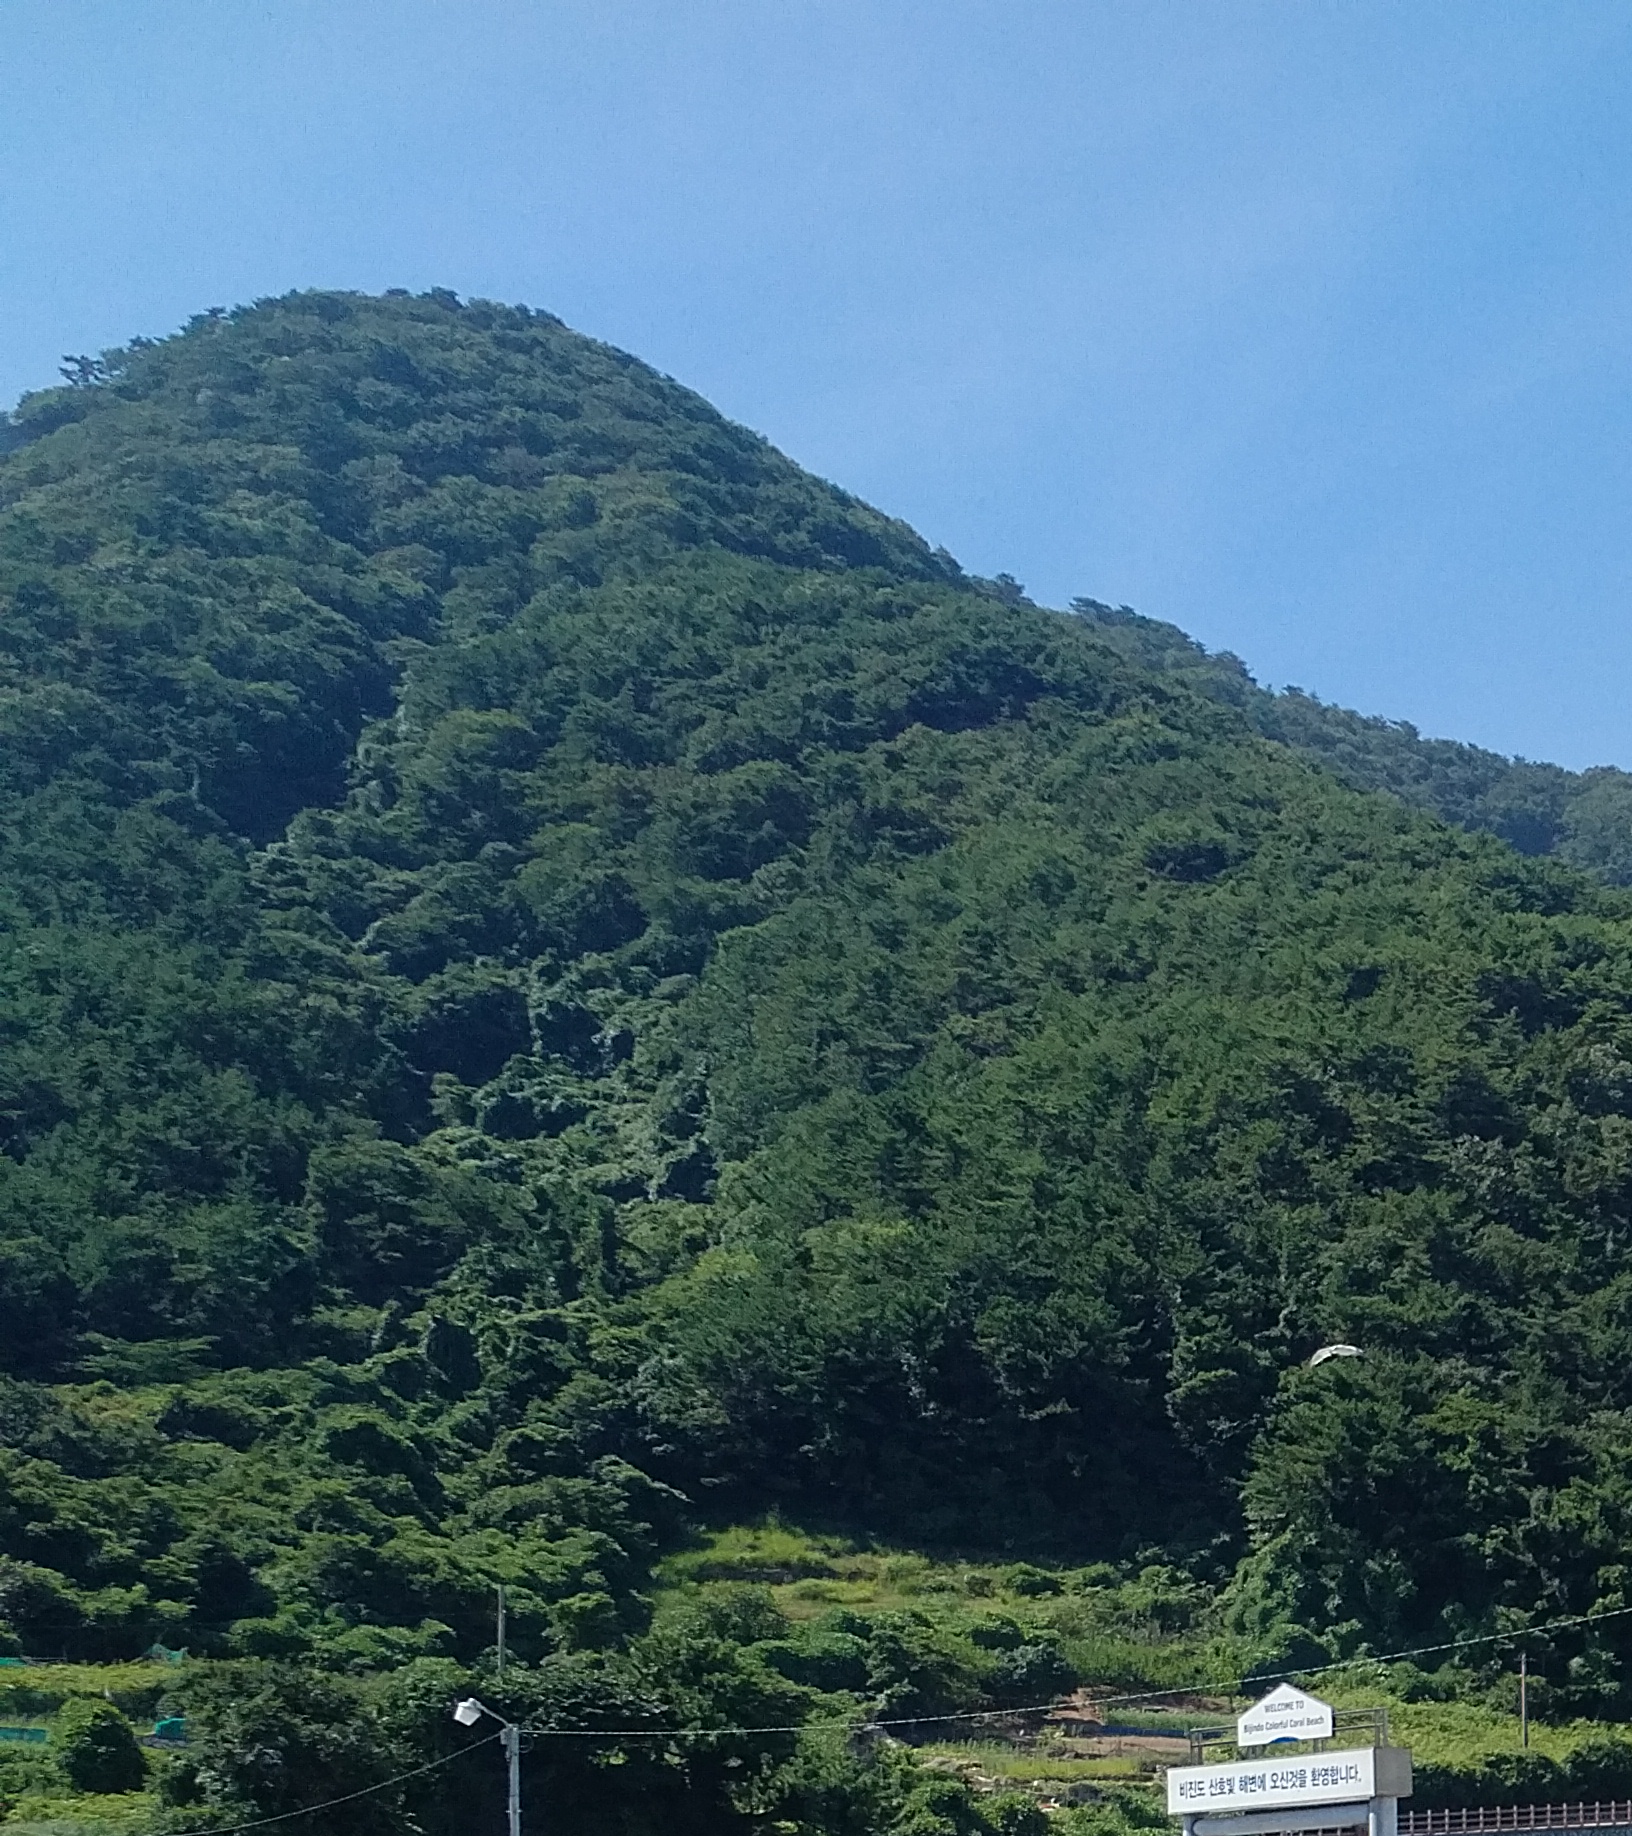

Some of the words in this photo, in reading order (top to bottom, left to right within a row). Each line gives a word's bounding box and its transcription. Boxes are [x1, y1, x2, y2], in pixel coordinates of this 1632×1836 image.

[1264, 1702, 1294, 1713] WELCOME
[1295, 1700, 1305, 1710] TO
[1265, 1719, 1288, 1731] Colorful
[1290, 1718, 1305, 1728] Coral
[1306, 1715, 1325, 1726] Beach
[1179, 1780, 1206, 1799] 비진도
[1208, 1777, 1235, 1797] 산호빛
[1238, 1773, 1267, 1793] 해변에
[1270, 1768, 1308, 1790] 오신것을
